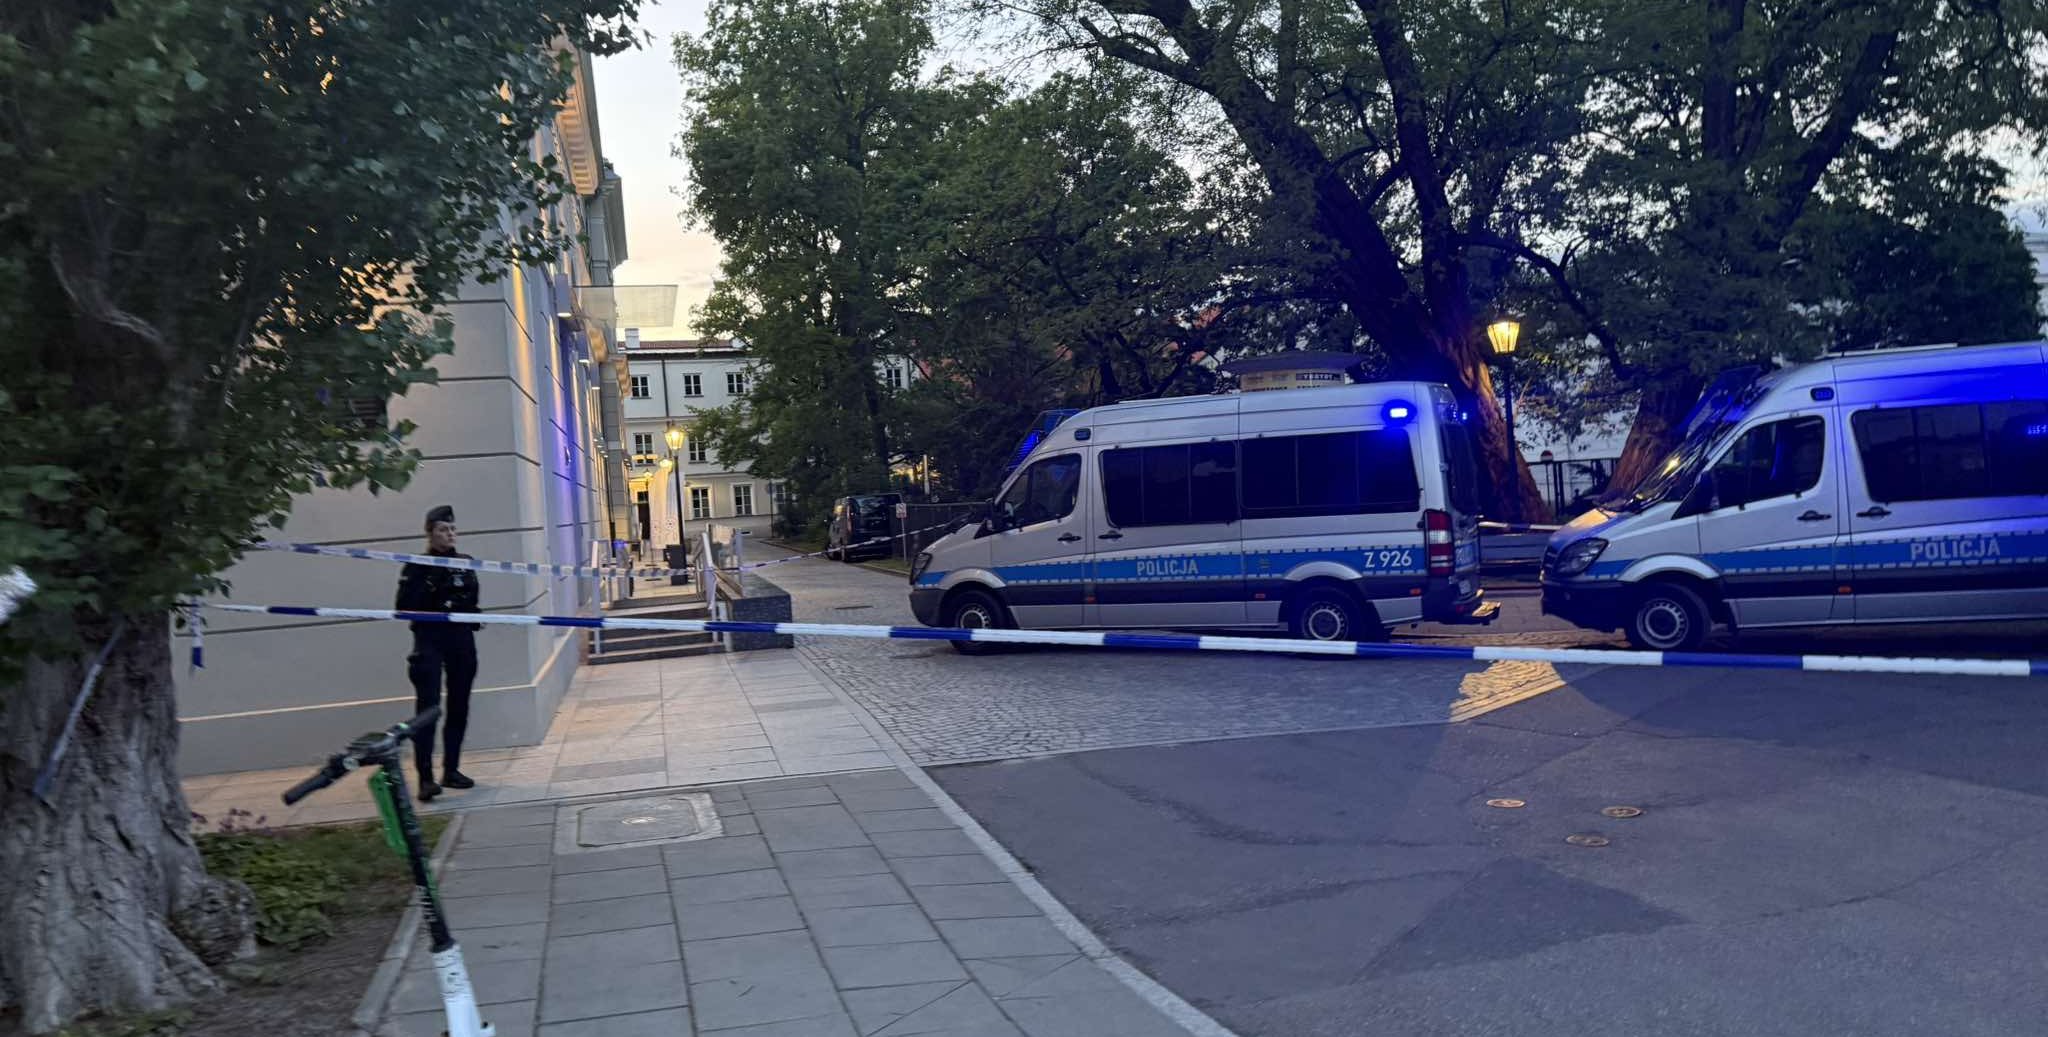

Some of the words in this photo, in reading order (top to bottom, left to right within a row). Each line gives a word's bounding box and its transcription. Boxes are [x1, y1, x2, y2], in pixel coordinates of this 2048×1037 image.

[1911, 538, 2000, 561] POLICJA
[1136, 559, 1199, 576] POLICJA
[1364, 551, 1376, 568] Z
[1379, 550, 1412, 568] 926
